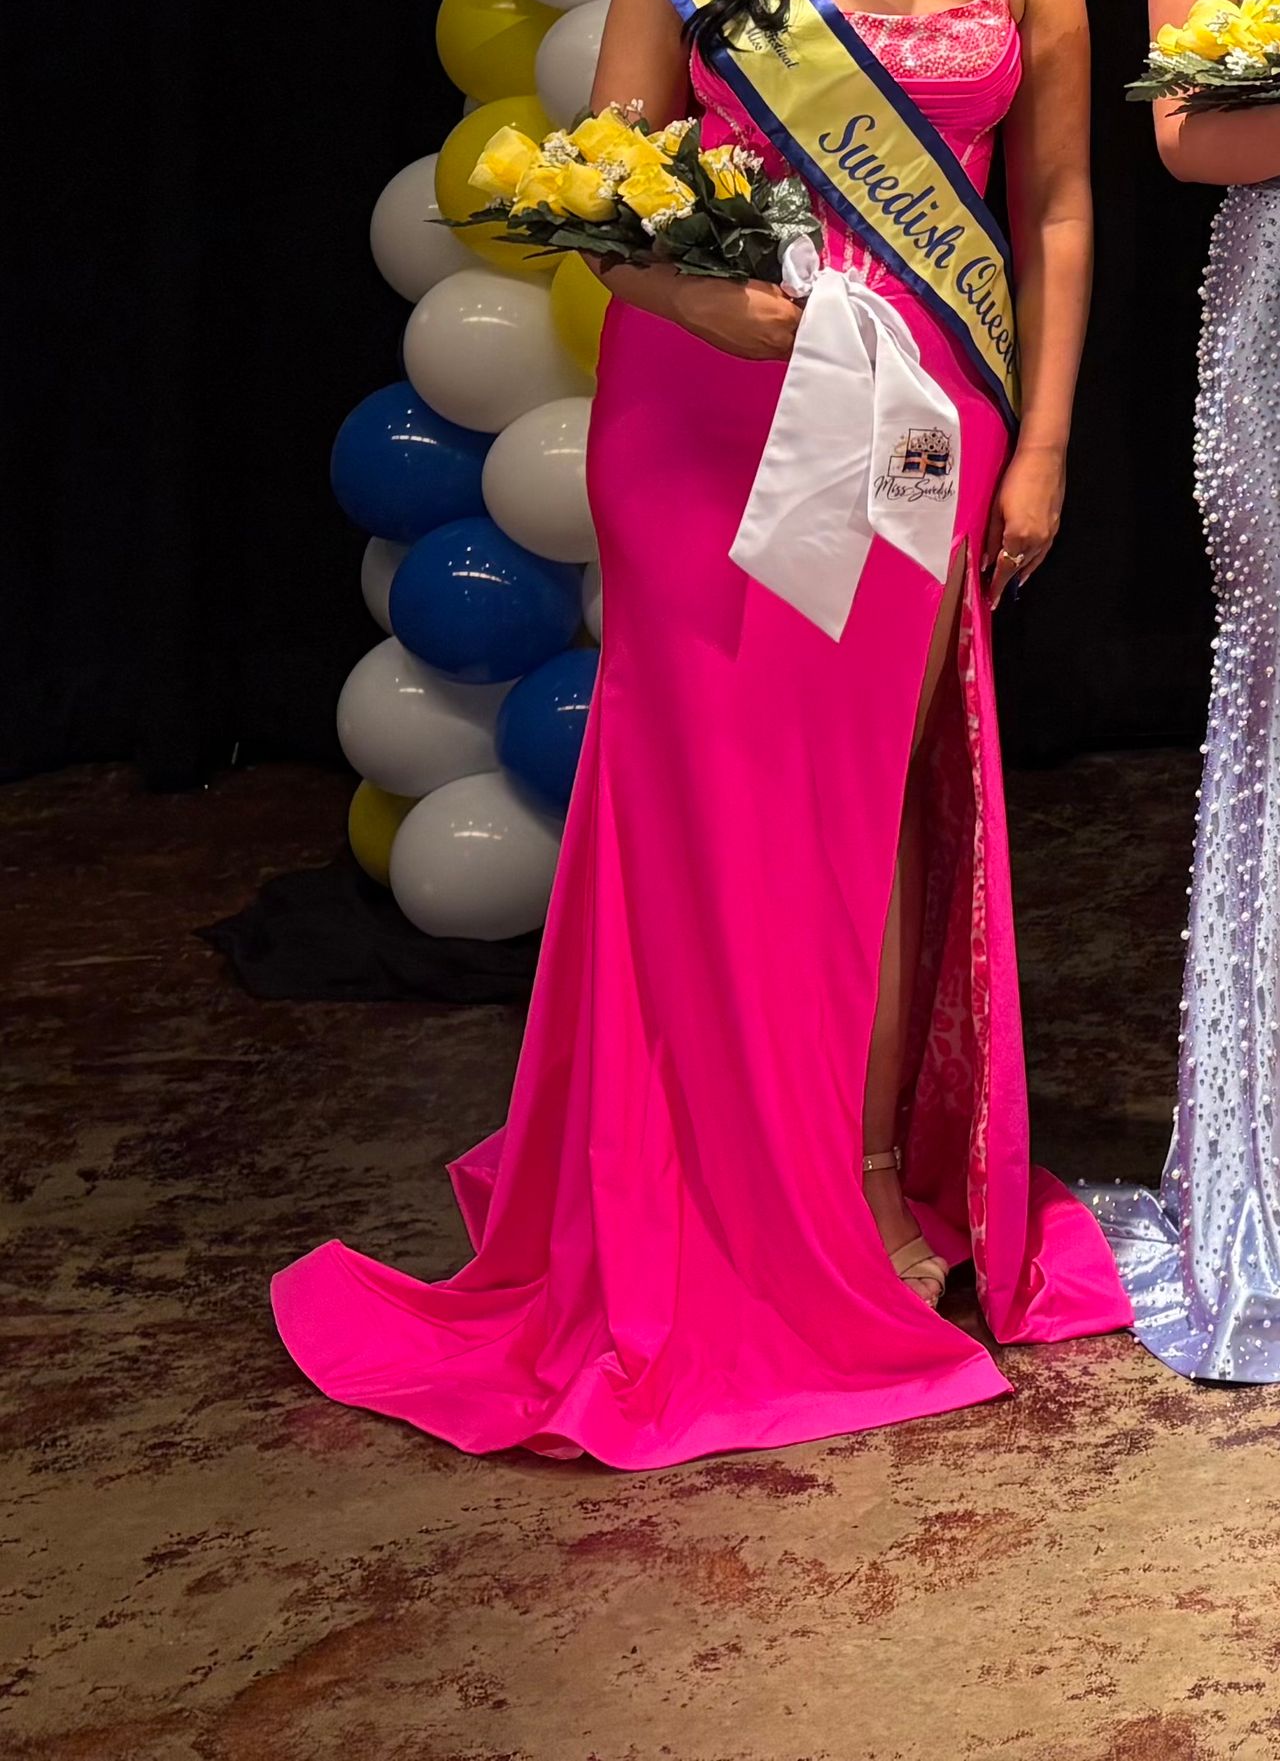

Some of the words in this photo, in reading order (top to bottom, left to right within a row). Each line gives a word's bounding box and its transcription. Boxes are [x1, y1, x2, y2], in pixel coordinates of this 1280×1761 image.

[818, 114, 966, 270] Swedish
[955, 256, 1017, 375] Queen
[874, 476, 906, 501] Miss
